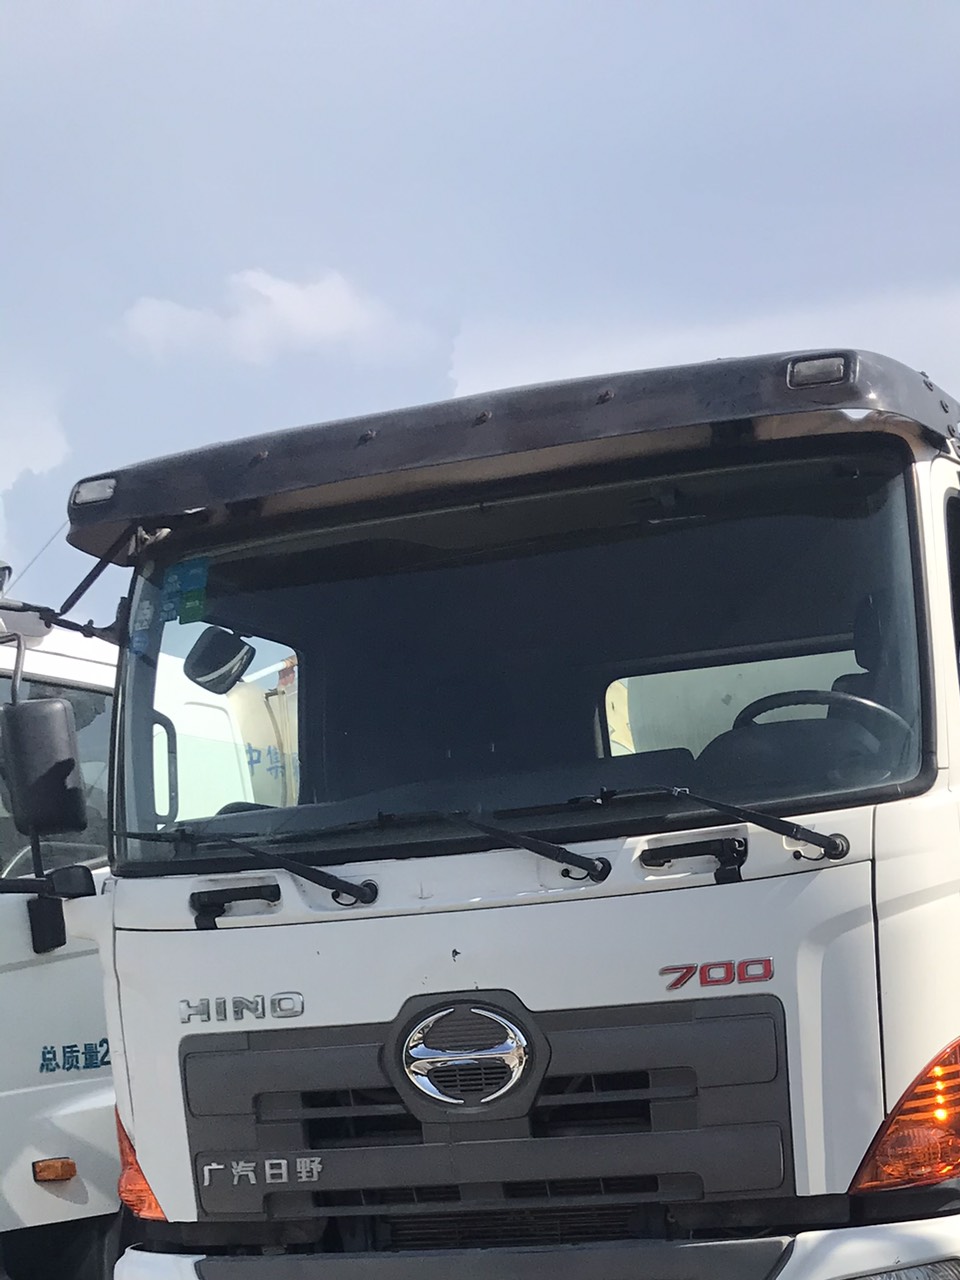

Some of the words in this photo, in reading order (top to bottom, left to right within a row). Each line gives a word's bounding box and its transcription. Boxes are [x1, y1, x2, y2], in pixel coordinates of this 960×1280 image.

[658, 956, 775, 992] 700
[178, 991, 305, 1024] HINO
[203, 1156, 323, 1187] 广汽日野
